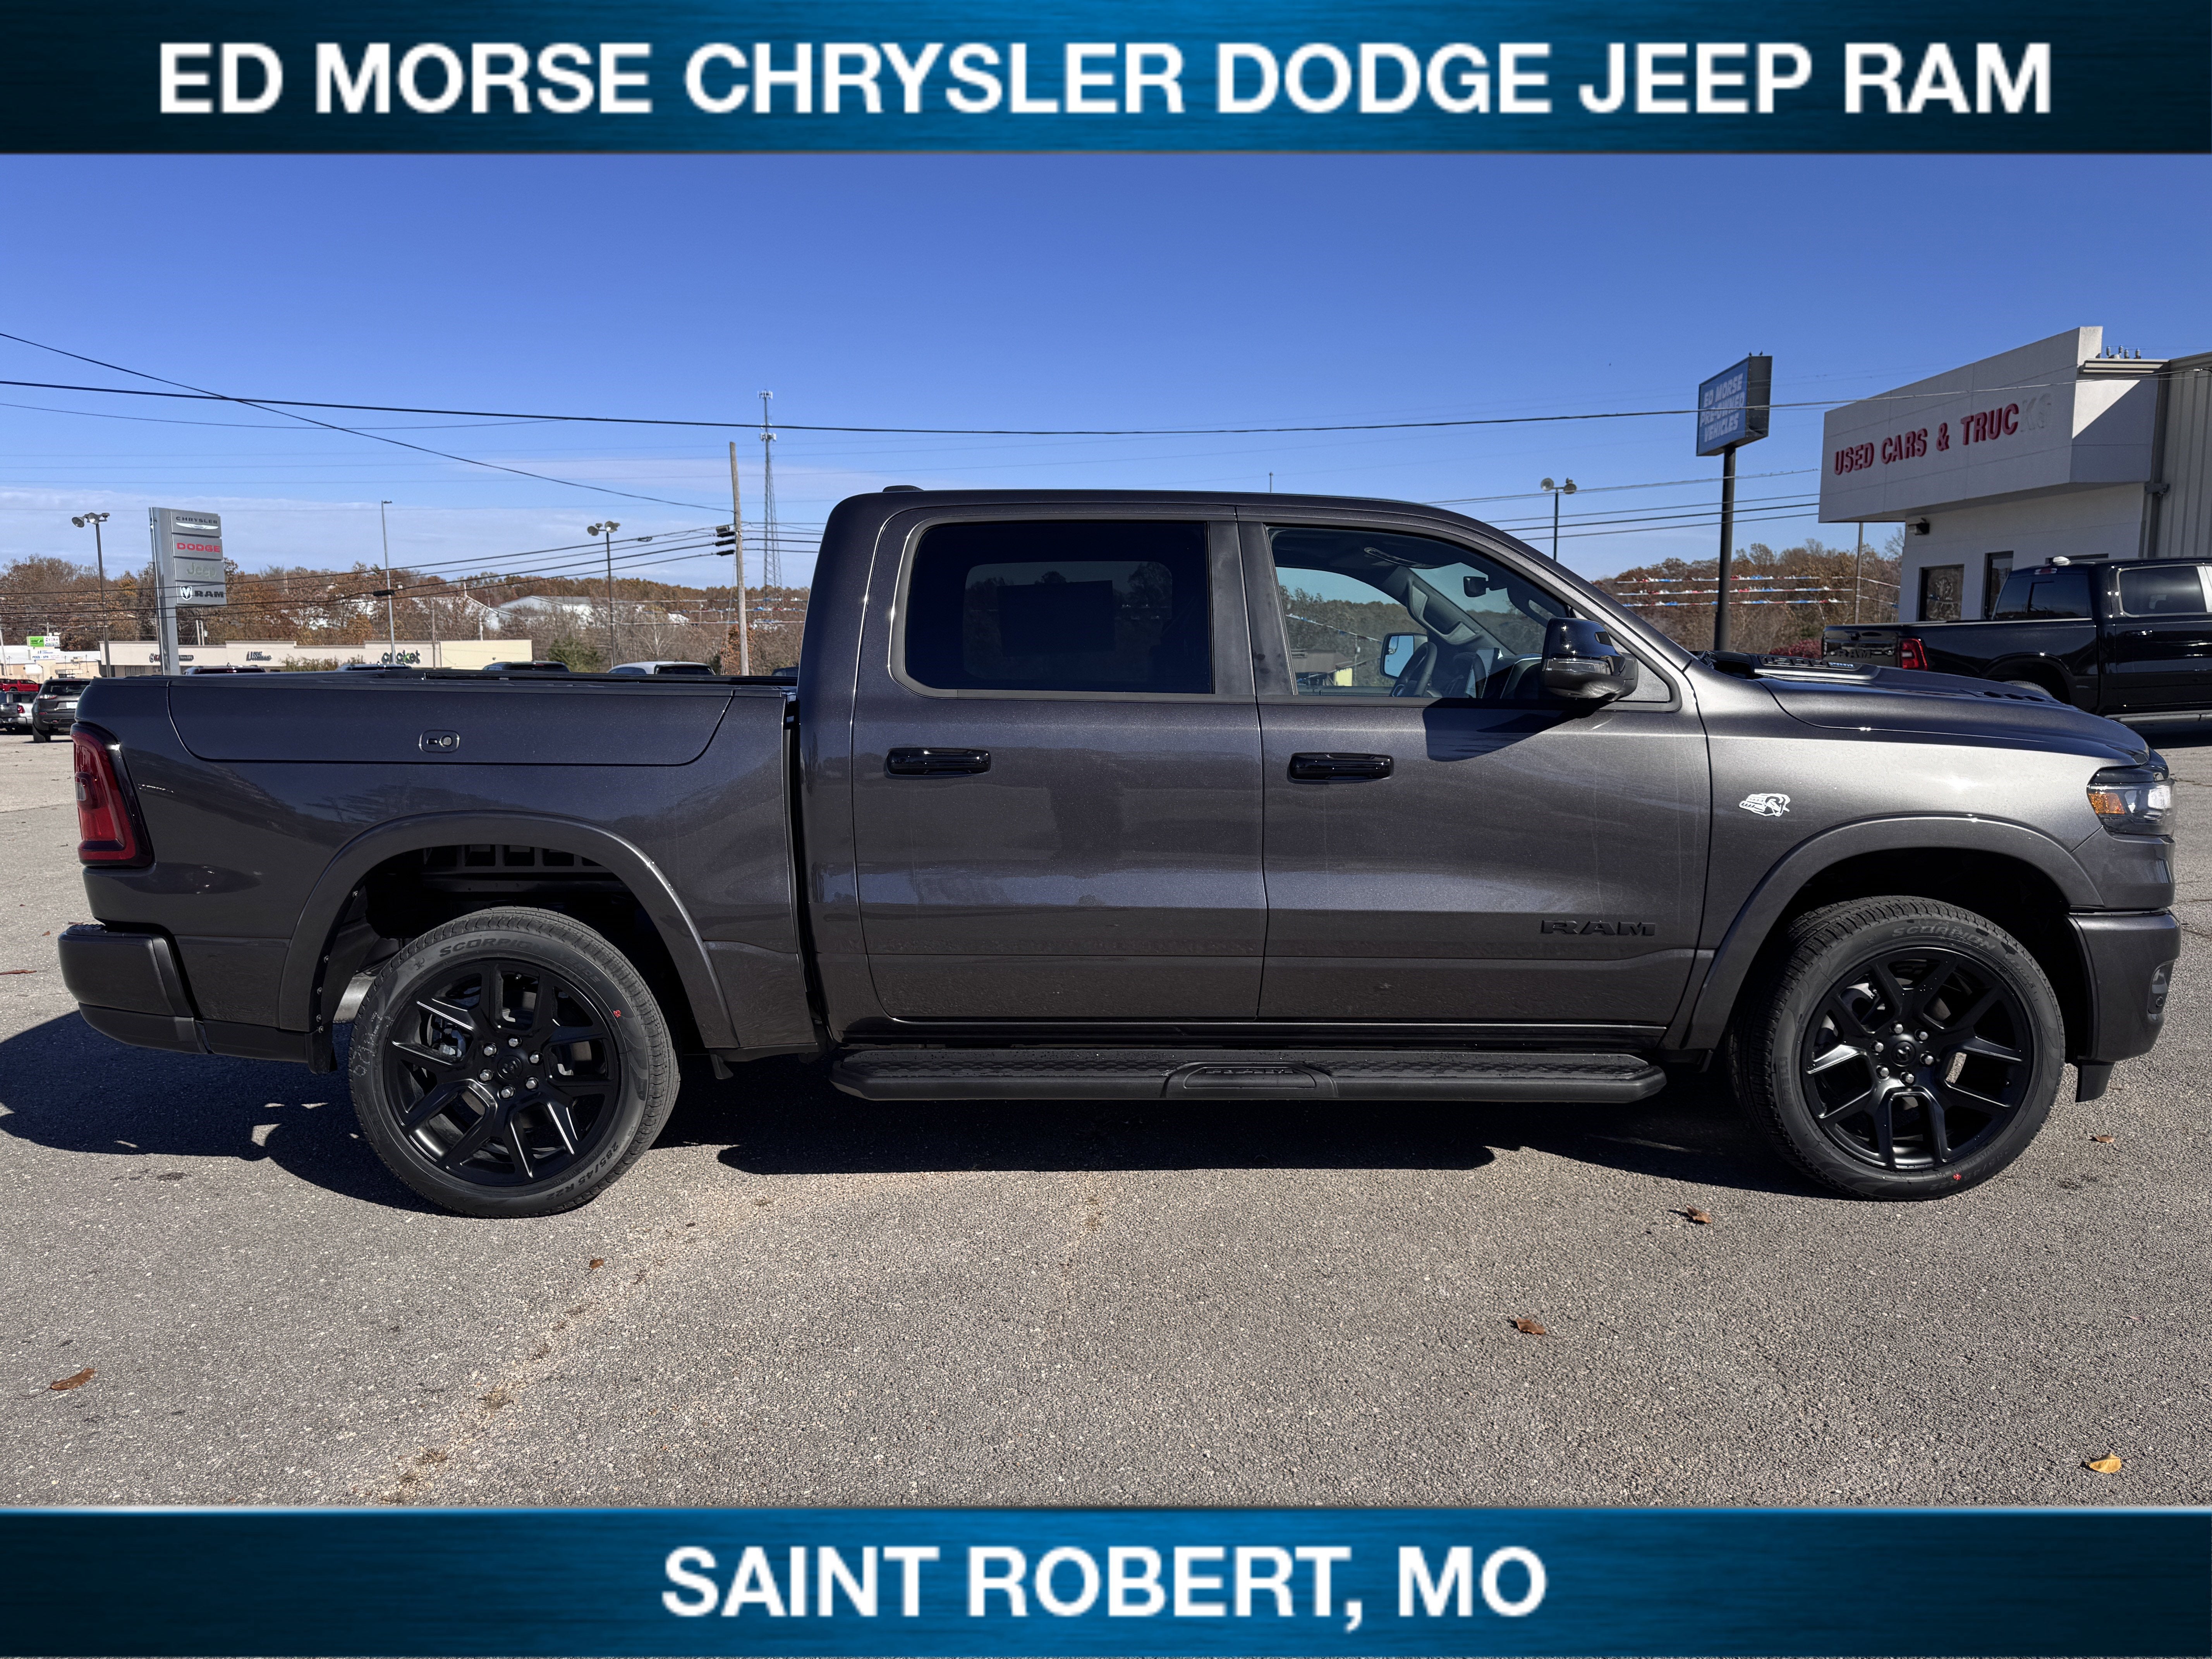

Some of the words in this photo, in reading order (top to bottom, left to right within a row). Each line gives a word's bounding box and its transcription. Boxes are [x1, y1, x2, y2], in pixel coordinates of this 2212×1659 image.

[1705, 389, 1714, 407] ED
[1716, 373, 1743, 403] MORSE
[1704, 412, 1739, 442] VEHICLES
[1834, 442, 1874, 476] USED
[1881, 428, 1928, 464] CARS
[1936, 422, 1949, 452] &
[177, 543, 220, 552] DODGE
[186, 562, 216, 579] Jeep
[1541, 920, 1656, 936] RAM
[578, 1141, 619, 1185] 285/45
[546, 1183, 574, 1201] R22
